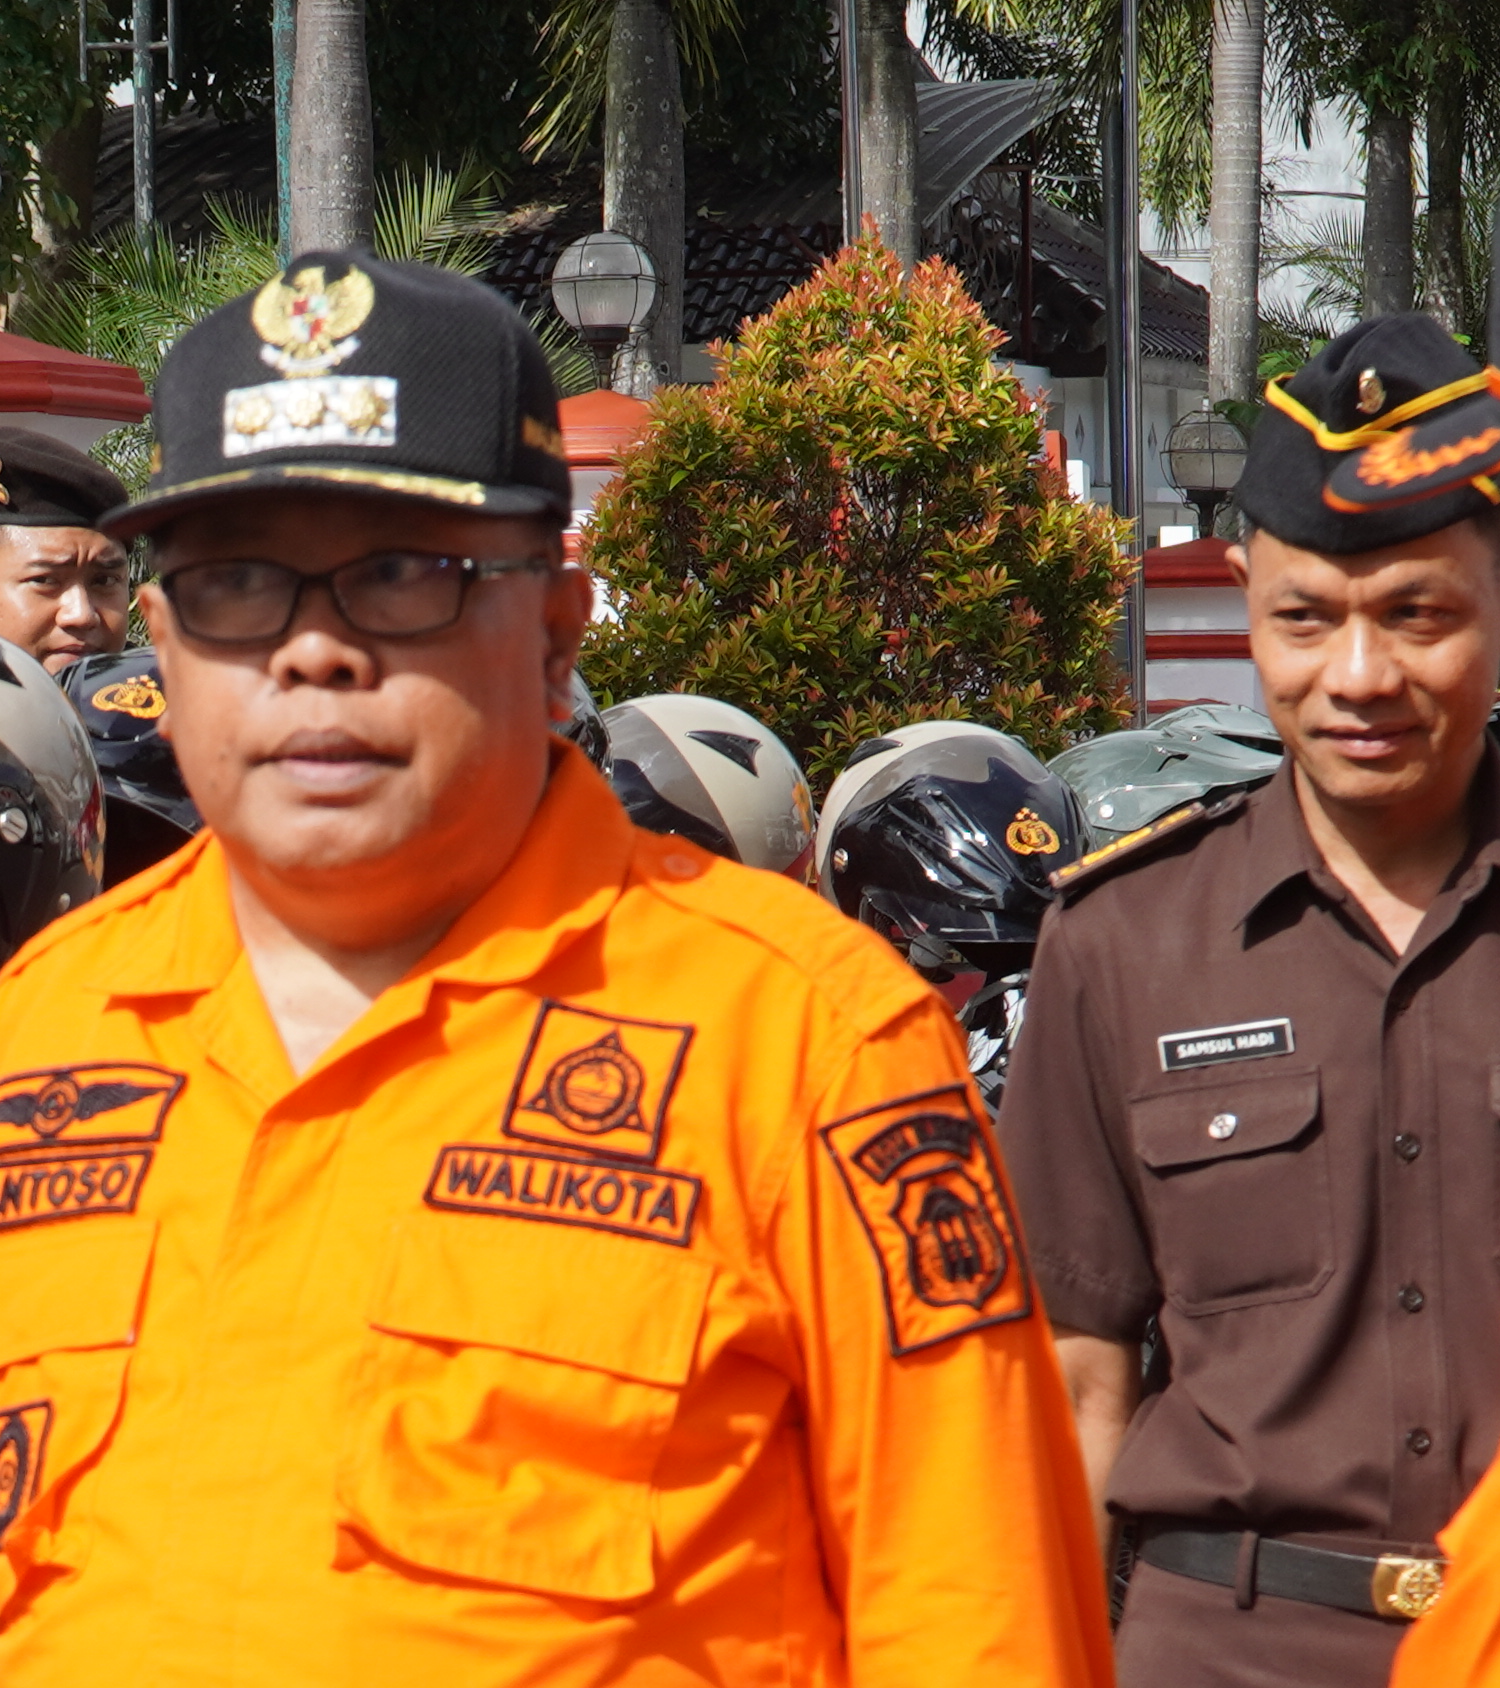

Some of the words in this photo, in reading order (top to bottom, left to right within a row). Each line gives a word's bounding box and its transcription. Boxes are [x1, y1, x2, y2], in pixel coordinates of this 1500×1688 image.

[1176, 1036, 1236, 1059] SAMSUL
[1236, 1031, 1276, 1049] HADI
[448, 1155, 679, 1229] WALIKOTA
